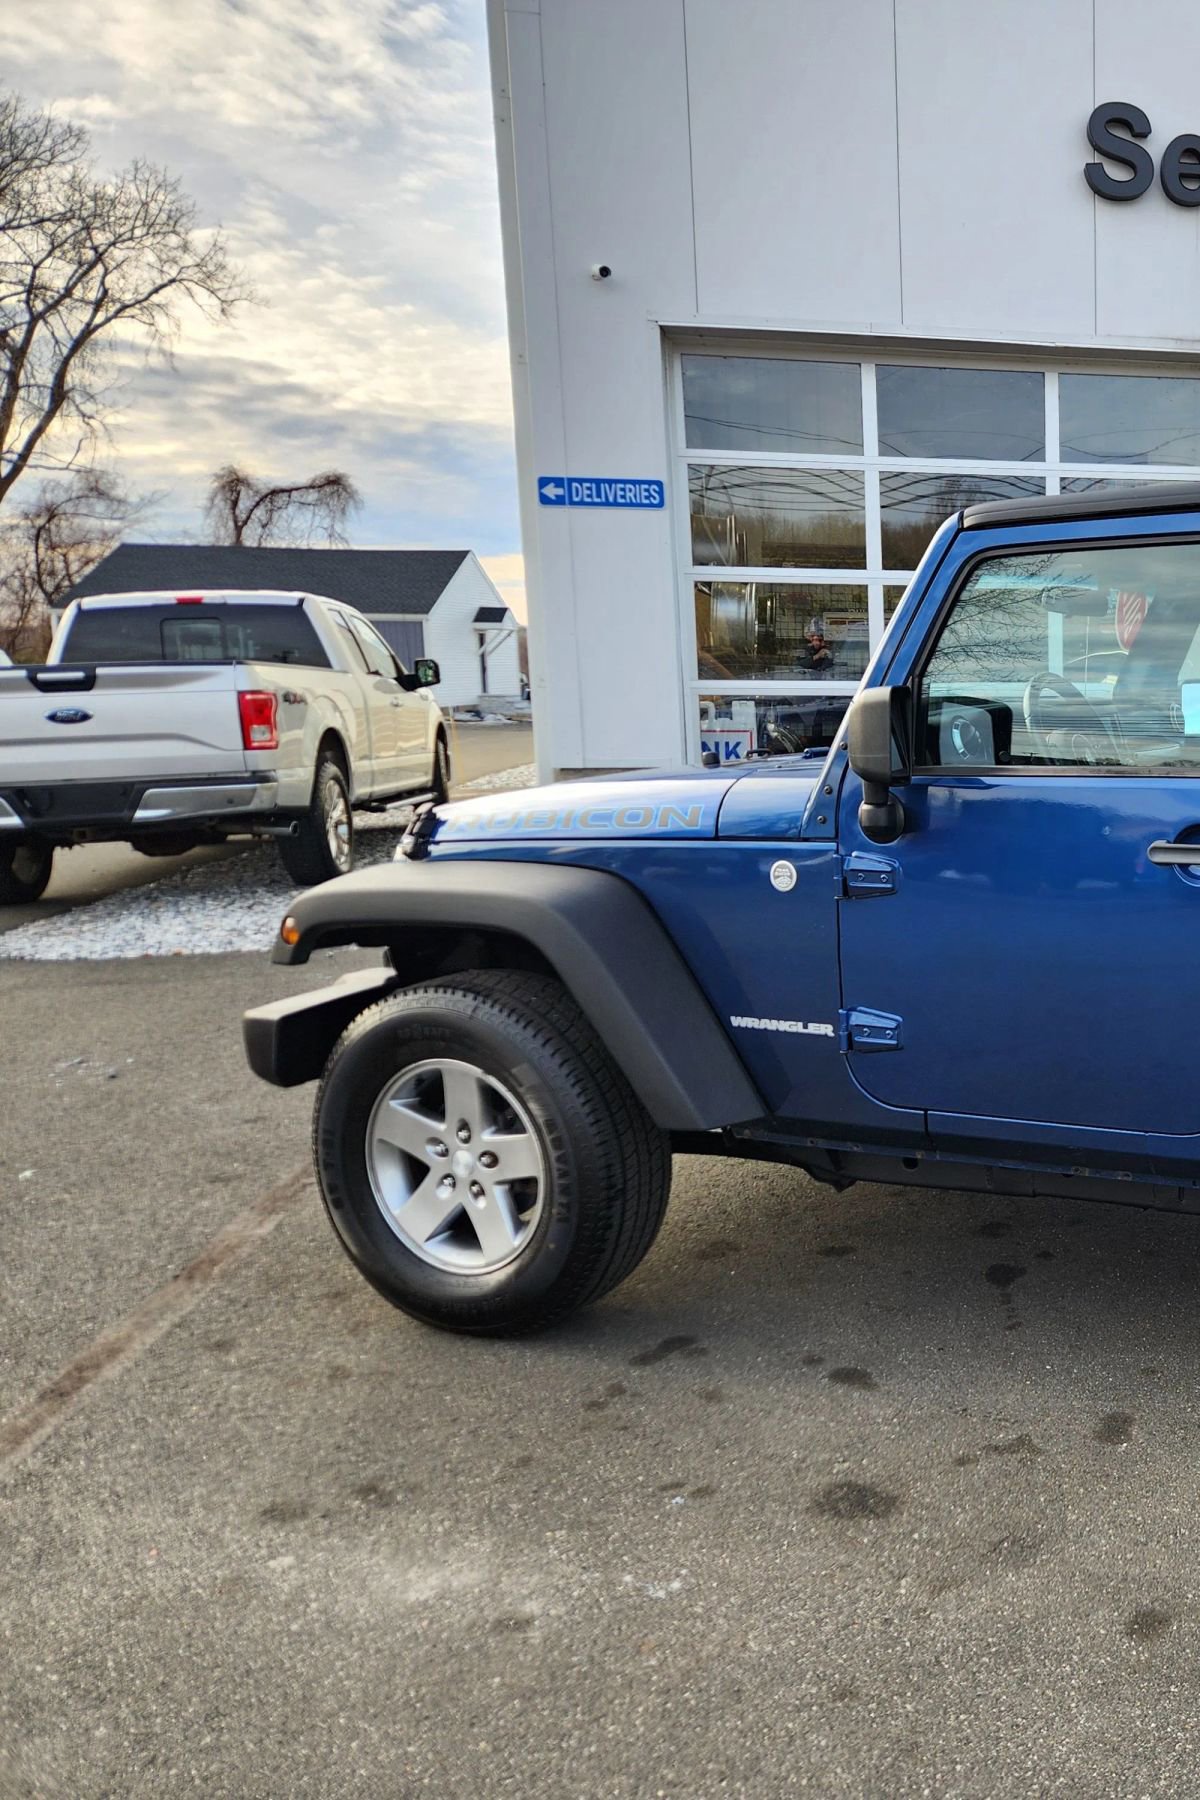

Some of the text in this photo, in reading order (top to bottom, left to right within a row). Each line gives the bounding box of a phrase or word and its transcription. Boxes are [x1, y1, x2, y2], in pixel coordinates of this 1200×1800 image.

[571, 482, 660, 504] DELIVERIES
[447, 804, 704, 832] RUBICON
[730, 1016, 835, 1037] WRANGLER
